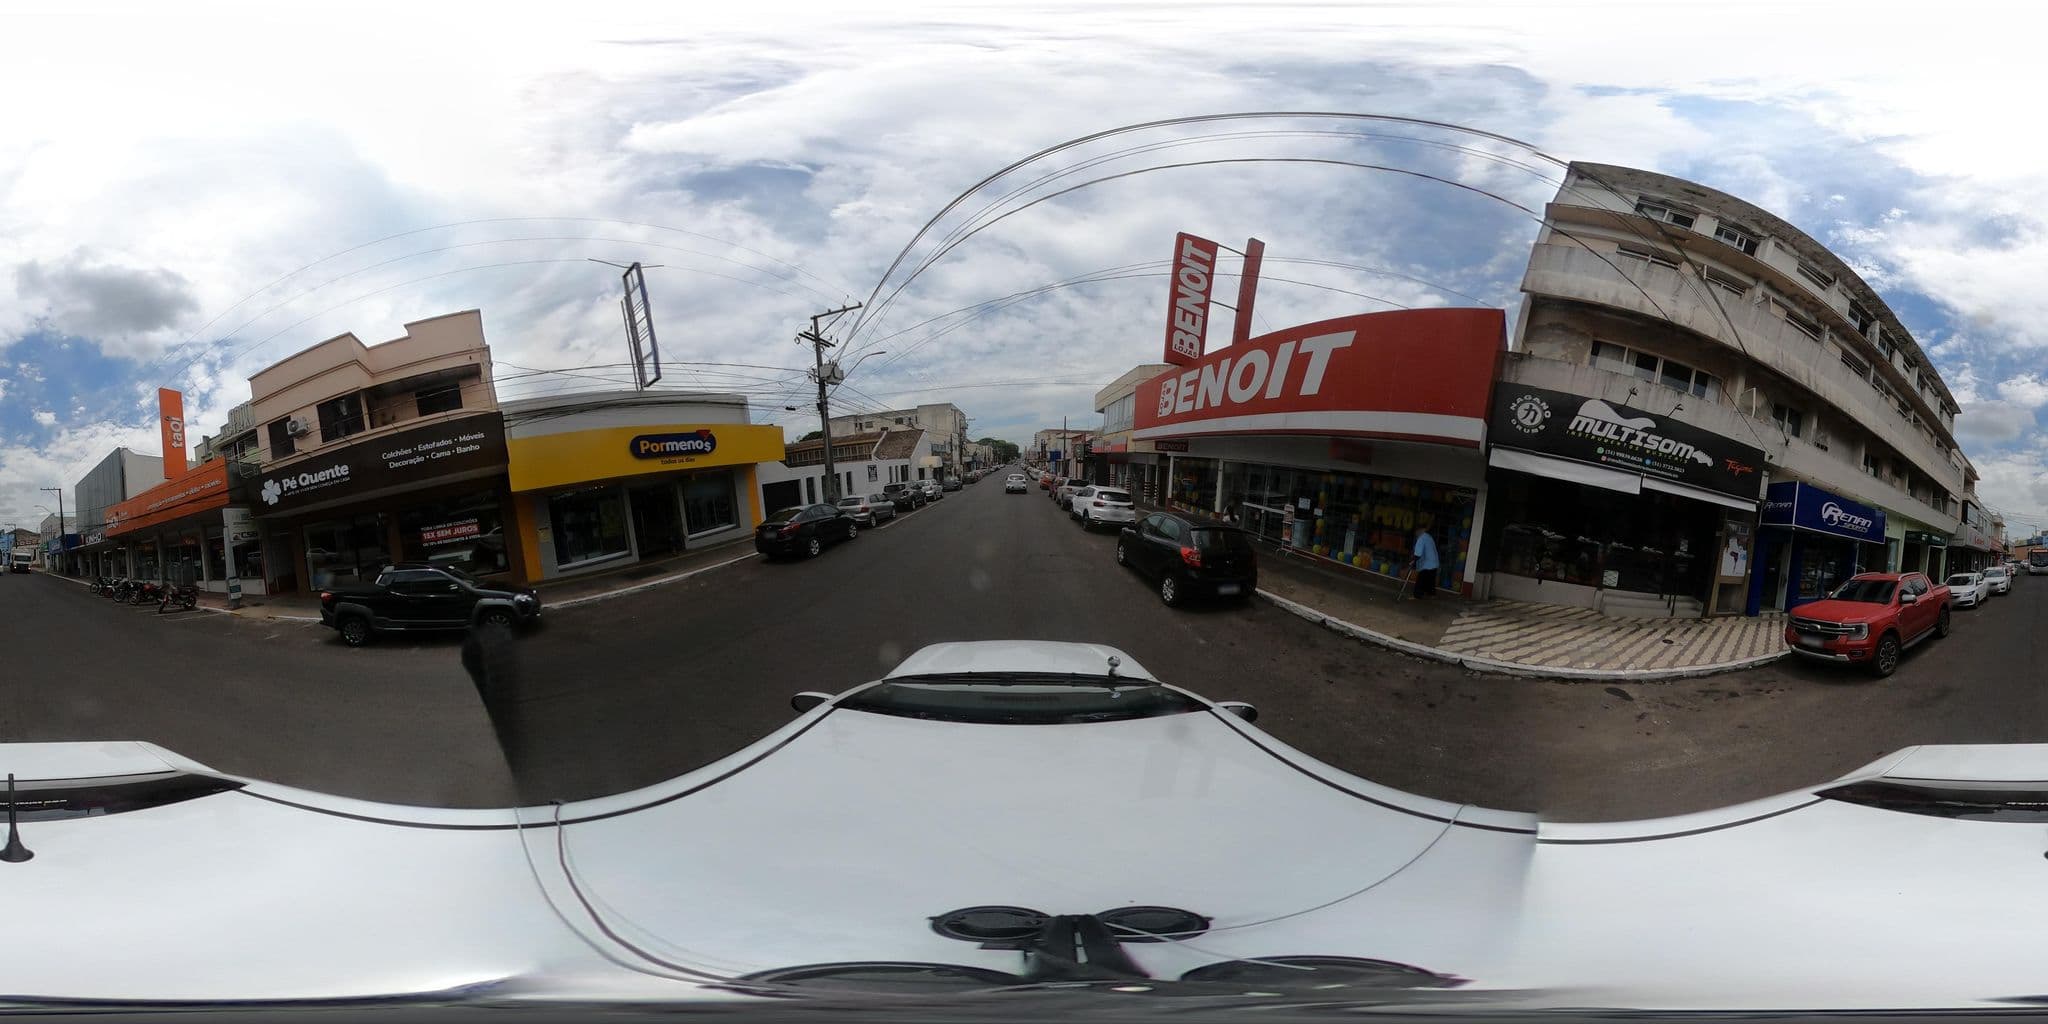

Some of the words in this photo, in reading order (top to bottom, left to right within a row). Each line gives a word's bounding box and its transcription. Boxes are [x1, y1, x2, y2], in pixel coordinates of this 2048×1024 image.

[1172, 238, 1212, 359] BENOIT
[1174, 343, 1197, 357] LOJAS
[1157, 330, 1357, 418] BENOIT
[1509, 394, 1552, 419] NAGANO
[1510, 418, 1546, 433] DRUMS
[1568, 415, 1695, 460] MULTISOM
[382, 447, 412, 460] Colchões
[418, 439, 453, 451] Estofados
[459, 432, 485, 442] Móveis
[1566, 430, 1640, 452] INSTRUMENTOS
[389, 456, 425, 469] Decoração
[430, 450, 451, 459] Cama
[456, 444, 480, 454] Banho
[282, 477, 298, 491] Pé
[299, 464, 350, 486] Quente
